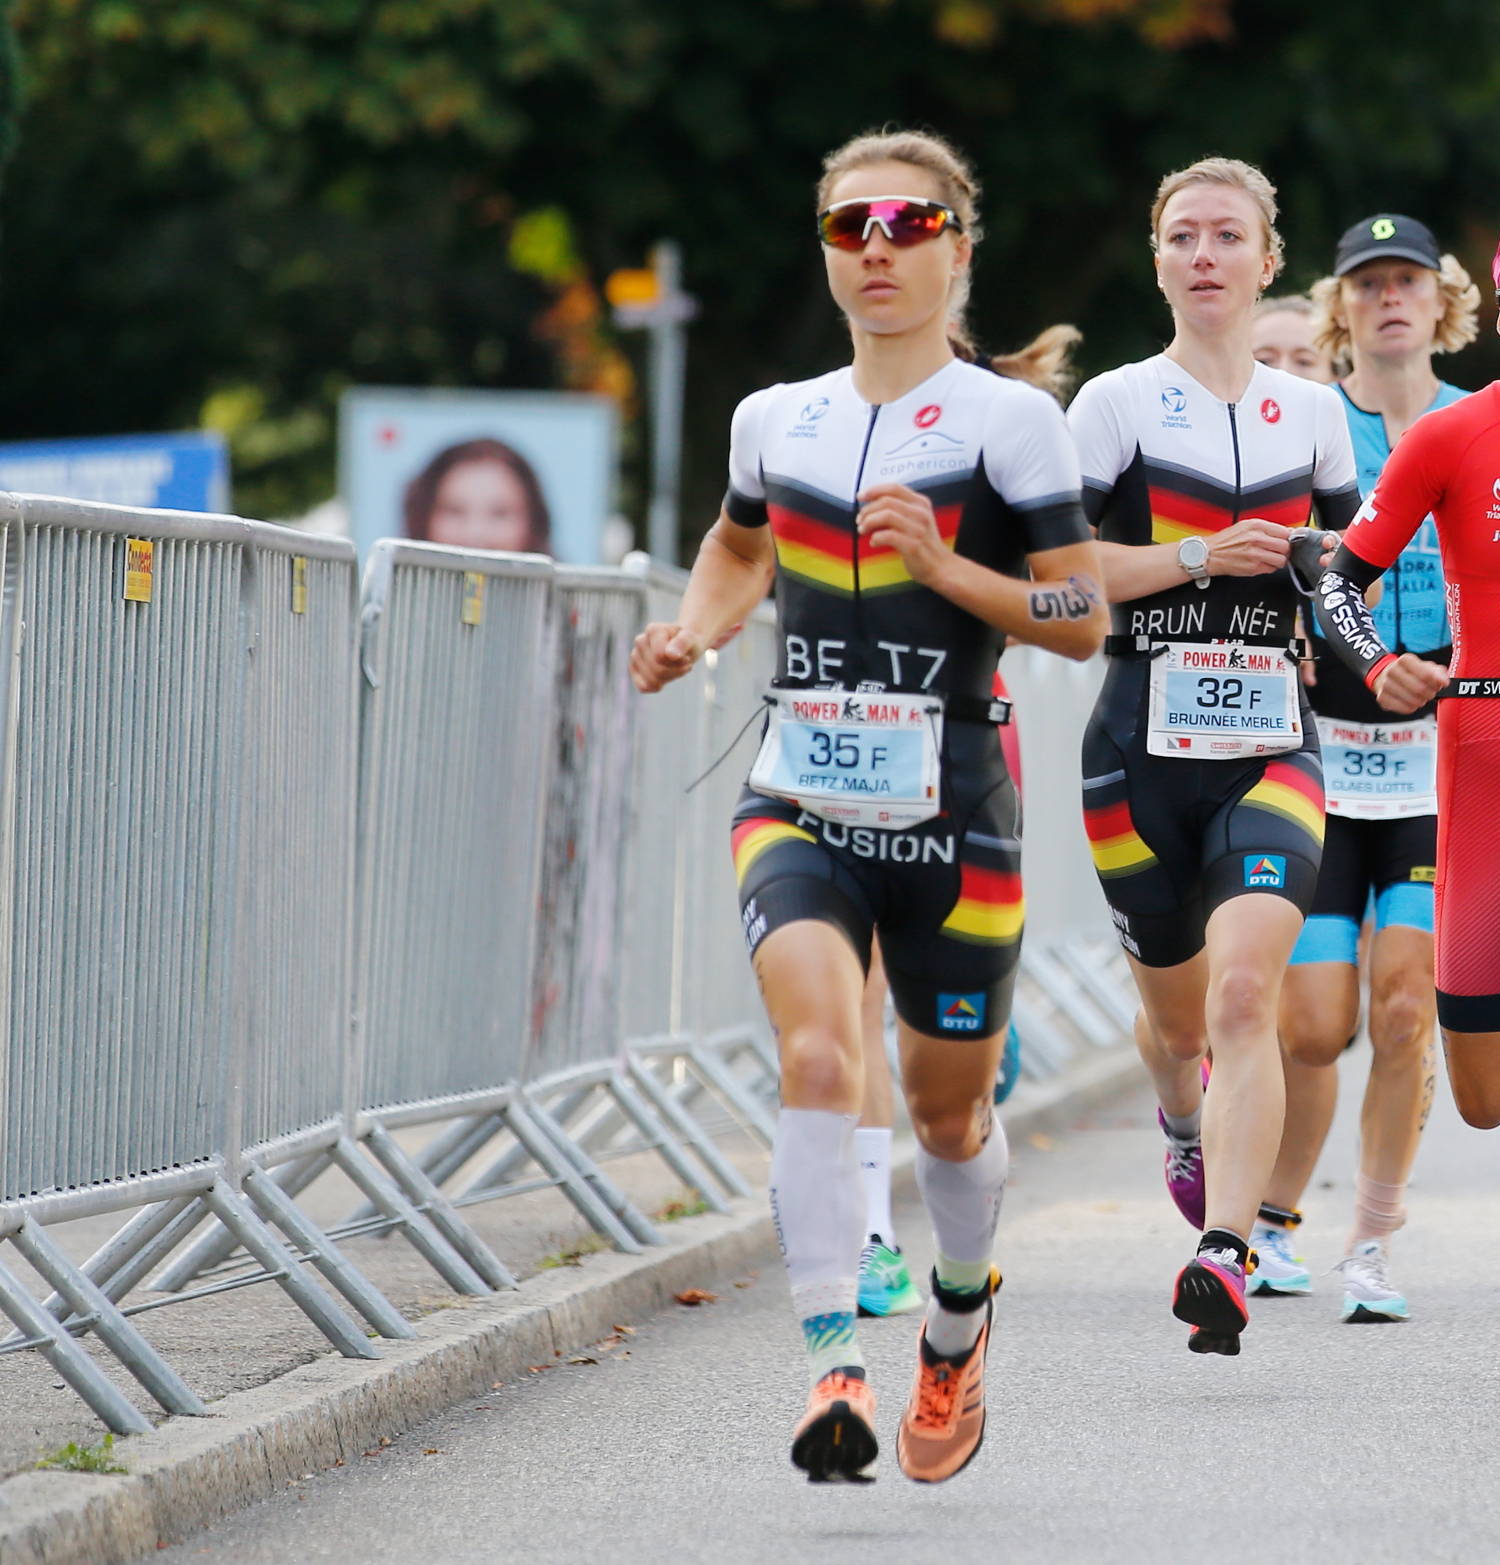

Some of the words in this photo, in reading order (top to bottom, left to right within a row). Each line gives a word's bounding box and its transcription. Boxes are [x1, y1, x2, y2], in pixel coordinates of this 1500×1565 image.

[1331, 604, 1381, 660] SWISS
[1184, 652, 1227, 668] POWER
[1248, 655, 1271, 671] MAN
[1196, 677, 1243, 709] 32
[1249, 690, 1261, 709] F
[1458, 681, 1480, 695] DT
[792, 702, 838, 720] POWER
[867, 705, 899, 723] MAN
[1241, 717, 1285, 729] MERLE
[809, 731, 860, 769] 35
[871, 747, 888, 770] F
[1343, 751, 1386, 776] 33
[1394, 761, 1407, 777] F
[799, 775, 836, 790] BETZ
[841, 777, 890, 793] MAJA
[1376, 783, 1415, 793] LOTTE
[796, 811, 955, 864] FUSION
[1250, 876, 1280, 885] DTU
[943, 1017, 978, 1030] DTU
